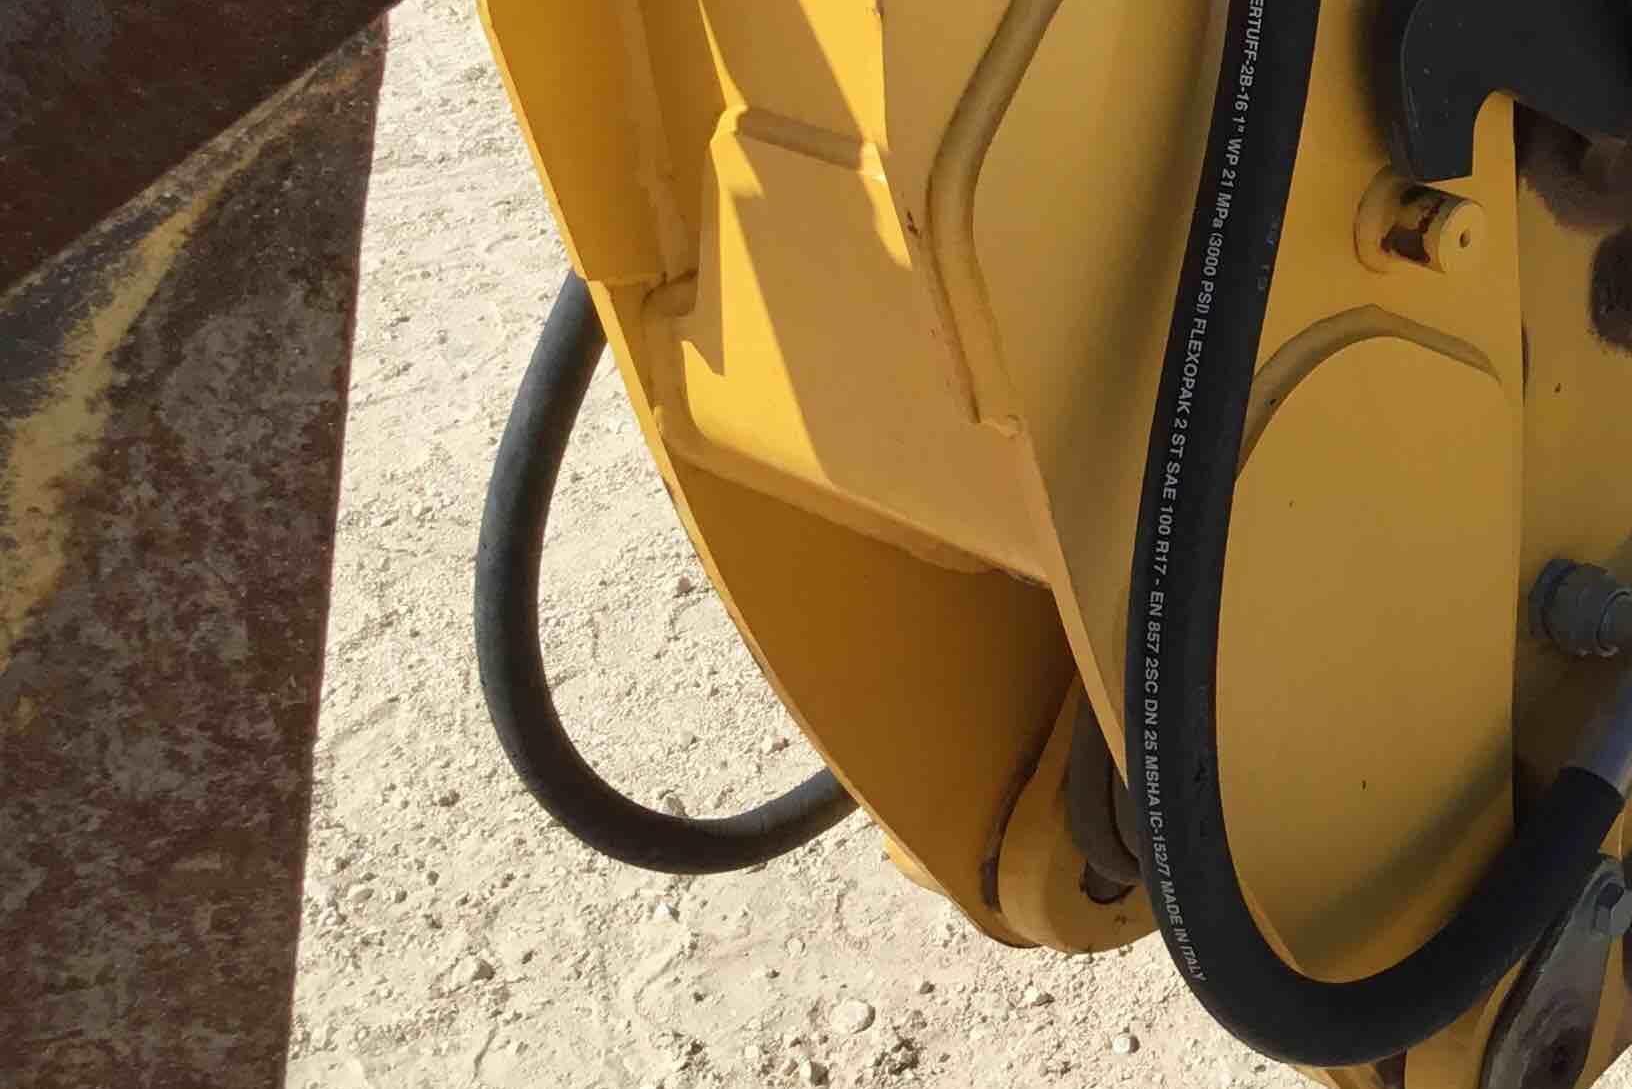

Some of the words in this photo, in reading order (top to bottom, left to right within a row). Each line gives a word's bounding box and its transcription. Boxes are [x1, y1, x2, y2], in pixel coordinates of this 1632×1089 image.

[1224, 137, 1242, 166] WP
[1220, 167, 1236, 187] 21
[1175, 317, 1207, 414] FLEXOPAK
[1173, 417, 1188, 429] 2
[1169, 432, 1186, 458] ST
[1161, 460, 1181, 500] SAE
[1157, 505, 1173, 536] 100
[1152, 539, 1170, 575] R17
[1148, 590, 1164, 617] EN
[1146, 620, 1161, 654] 857
[1144, 656, 1159, 694] 2SC
[1144, 698, 1158, 725] DN
[1144, 729, 1158, 750] 25
[1146, 754, 1161, 806] MSHA
[1161, 879, 1183, 925] MADE
[1173, 927, 1190, 943] IN
